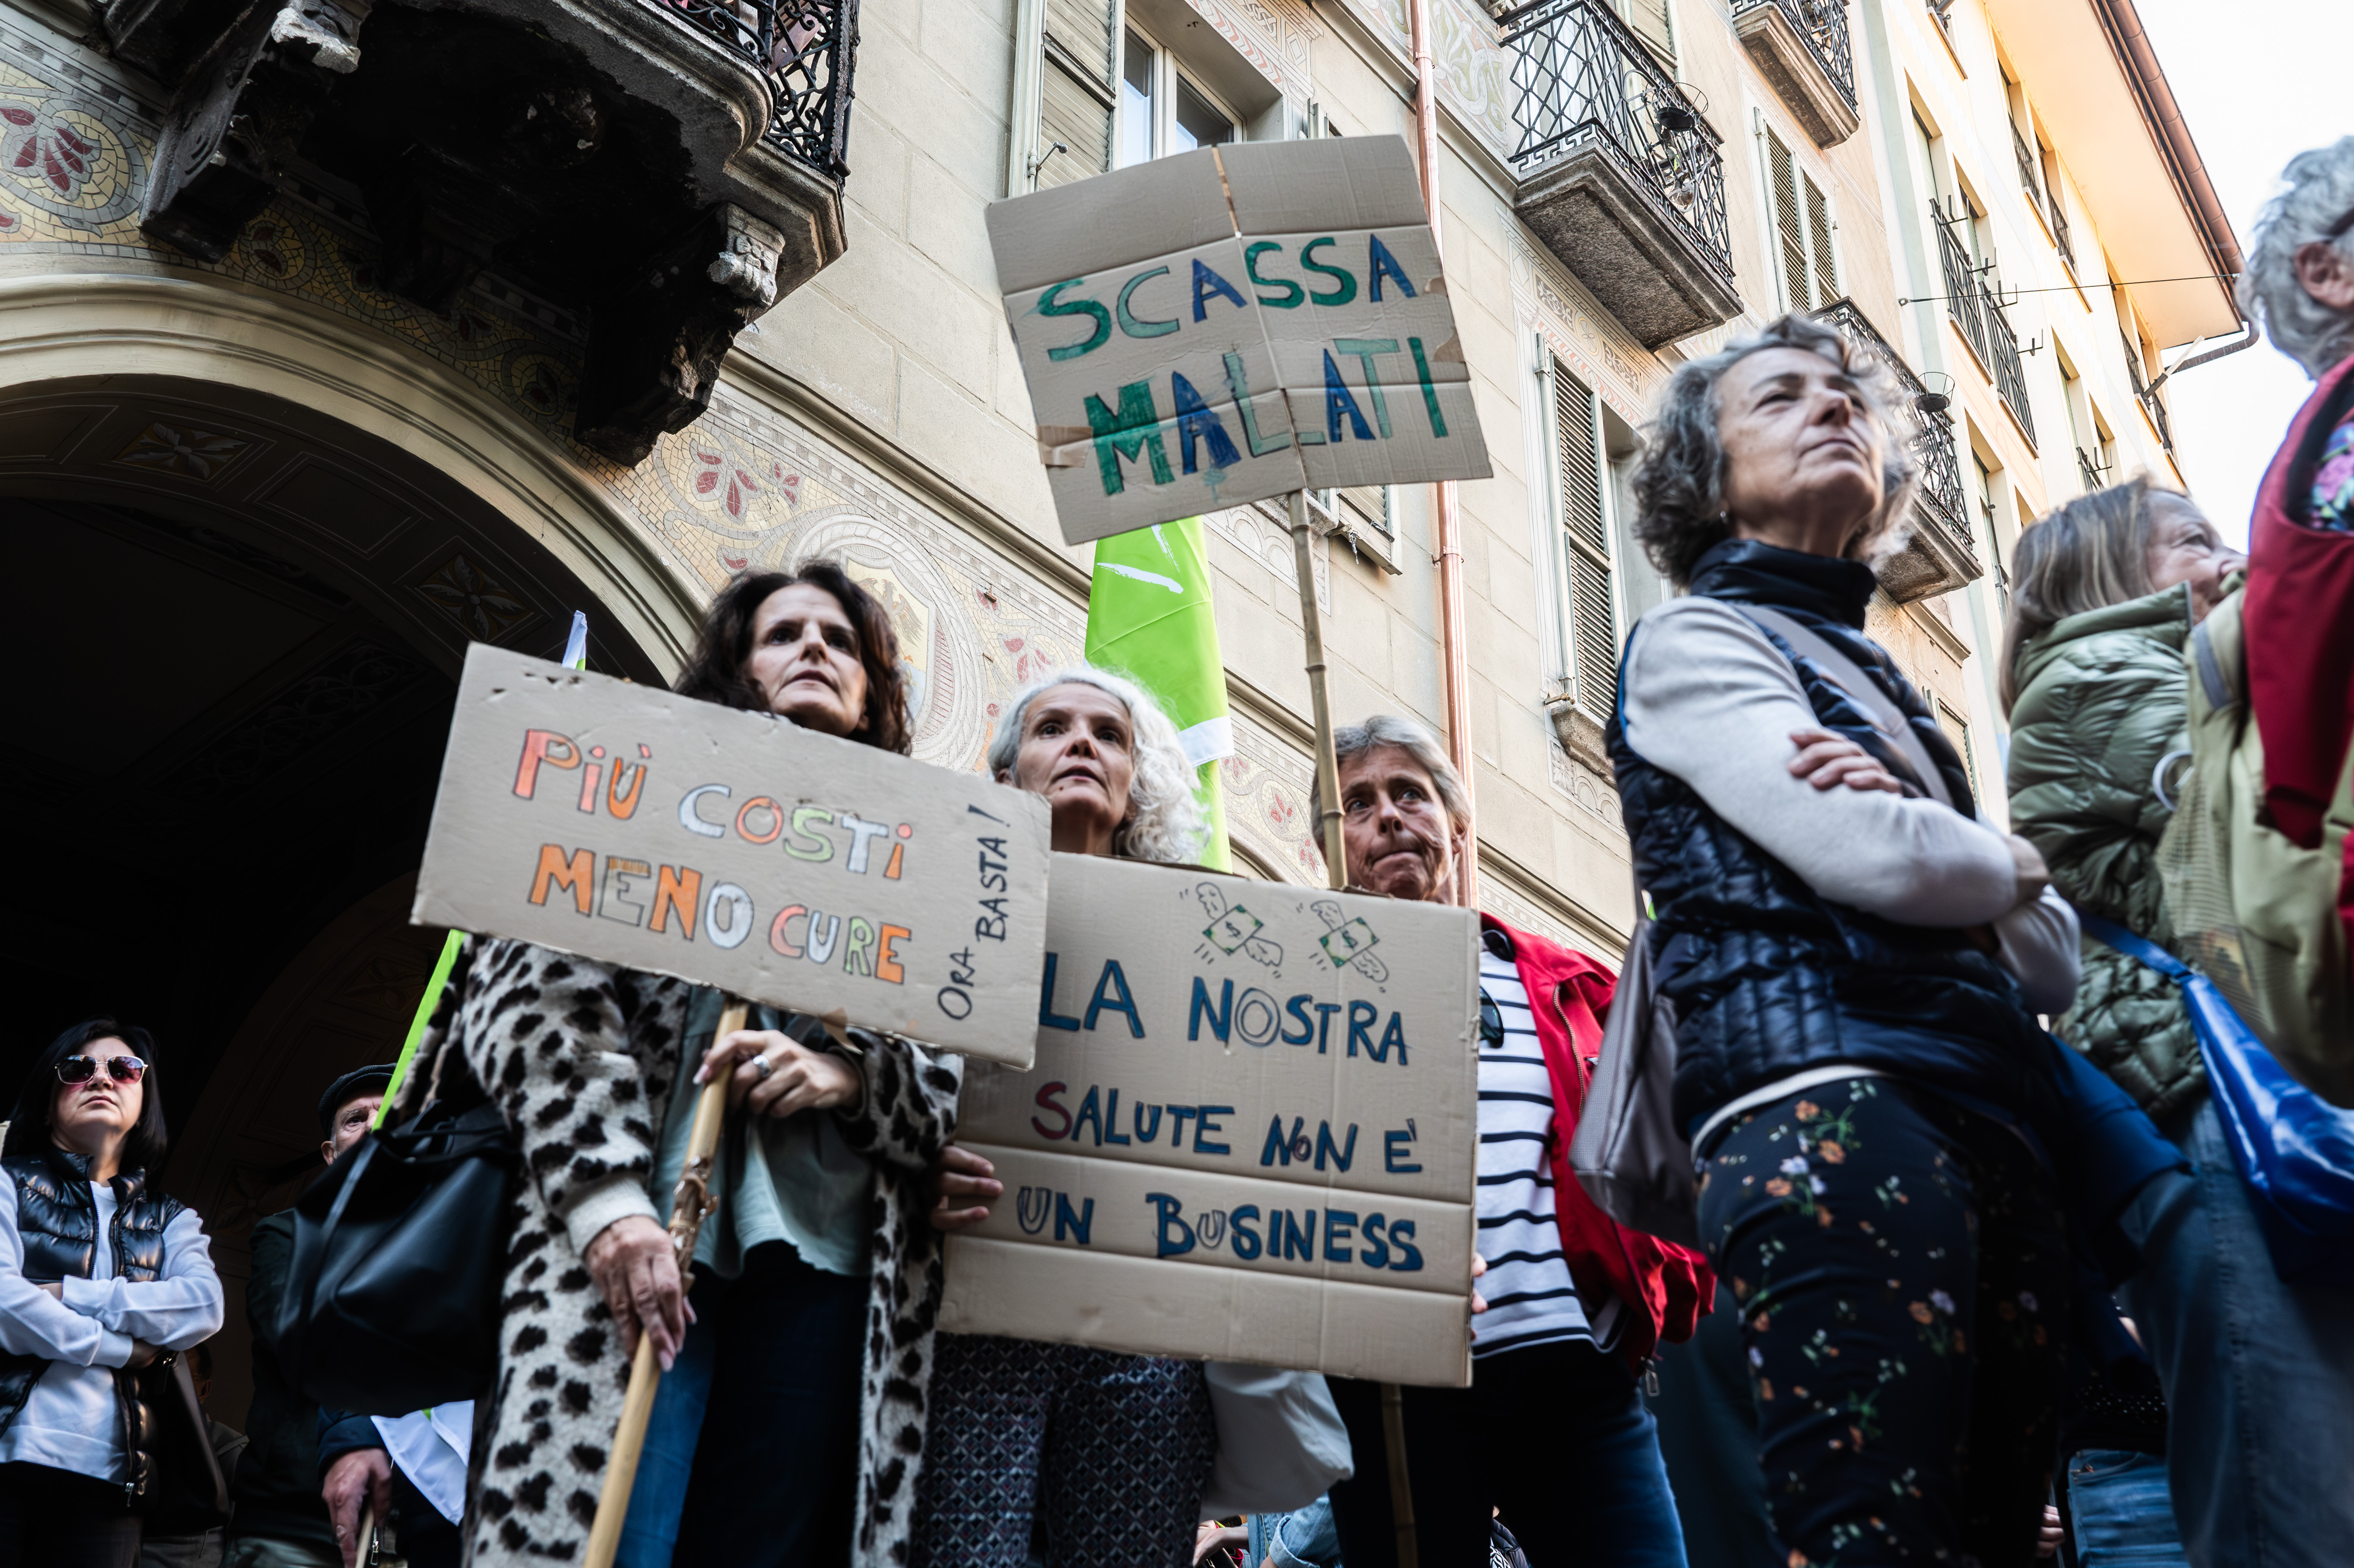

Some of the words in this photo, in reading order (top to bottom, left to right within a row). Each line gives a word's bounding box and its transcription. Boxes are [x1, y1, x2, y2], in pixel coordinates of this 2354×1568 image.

[1034, 232, 1418, 363] SCASSA
[1082, 336, 1449, 496] MALATI
[528, 843, 754, 949] MENO
[768, 904, 912, 985] CURE
[938, 946, 975, 1020] ORA
[967, 803, 1011, 942] BASTA!
[1039, 951, 1146, 1039] LA
[1188, 977, 1410, 1066] NOSTRA
[1030, 1082, 1235, 1155] SALUTE
[1384, 1118, 1423, 1173] È
[1016, 1186, 1094, 1245] UN
[1145, 1192, 1424, 1272] BUSINESS
